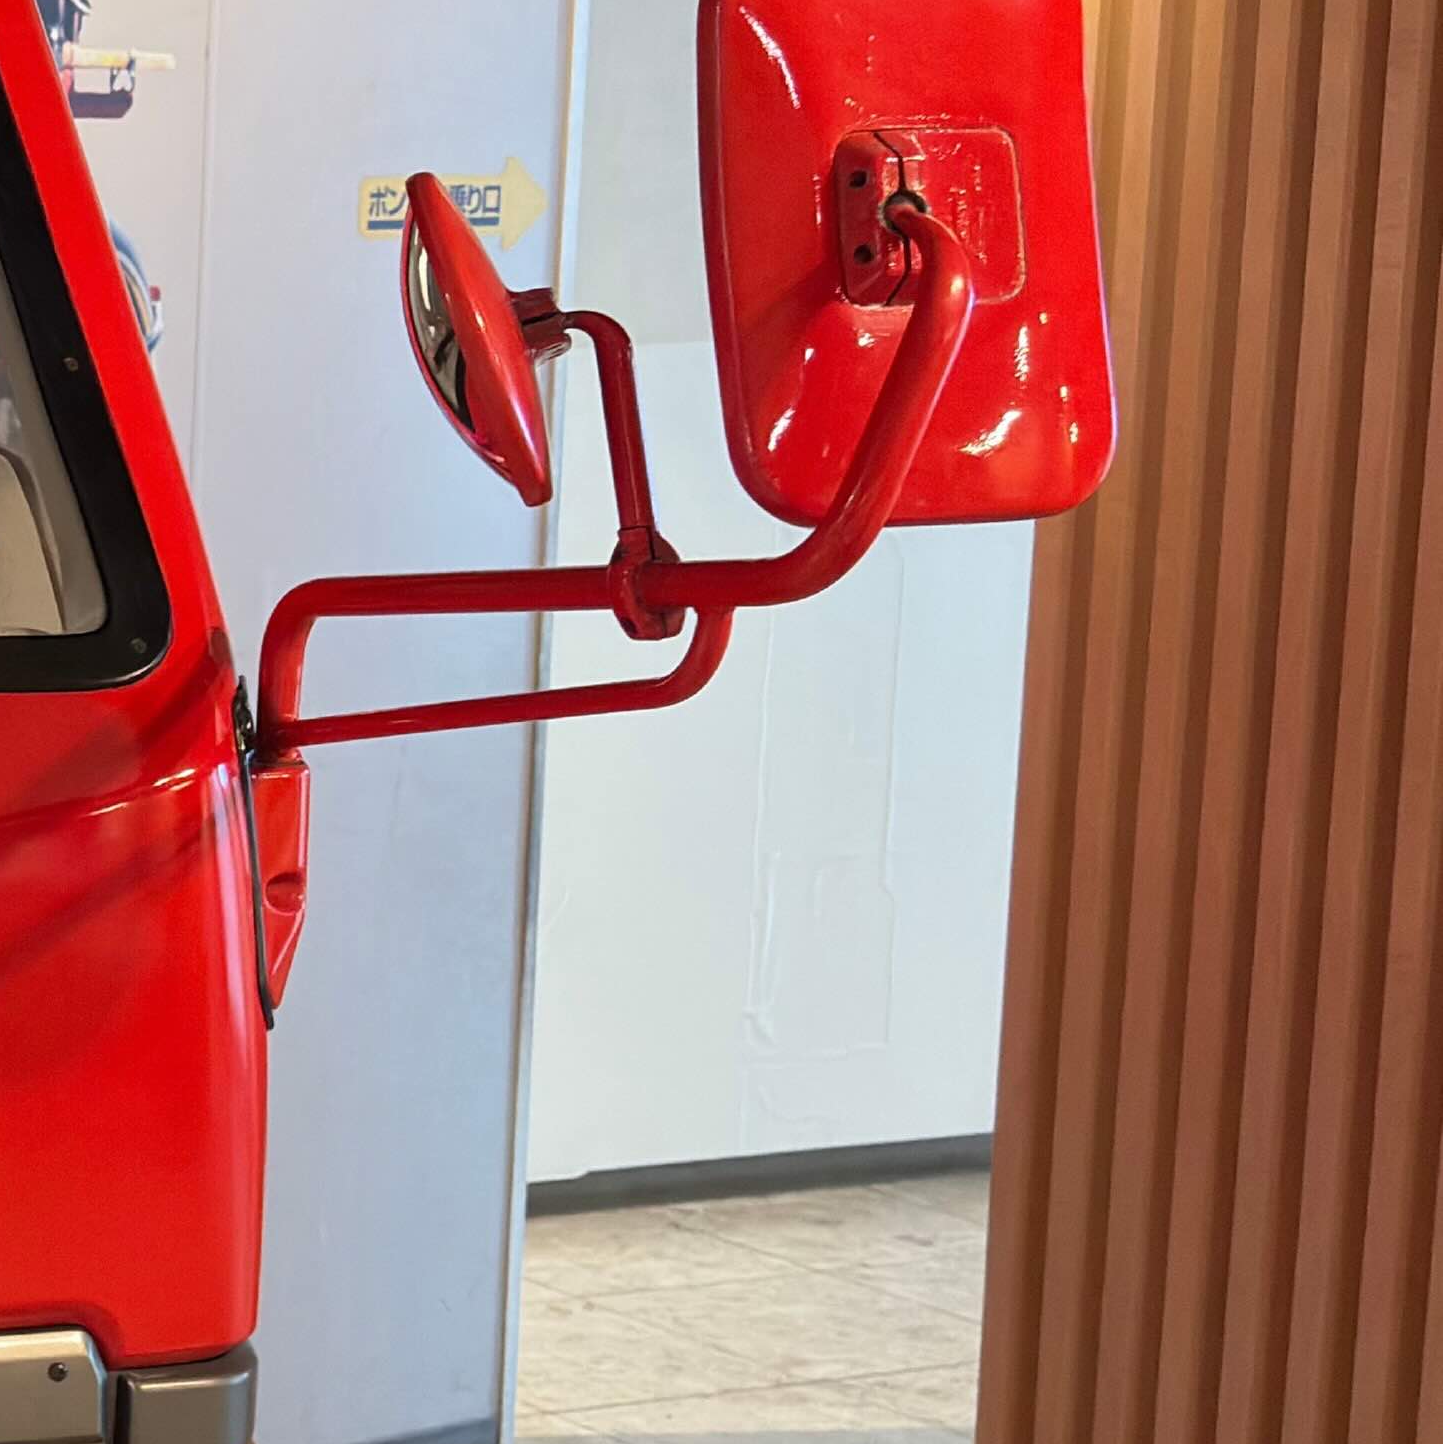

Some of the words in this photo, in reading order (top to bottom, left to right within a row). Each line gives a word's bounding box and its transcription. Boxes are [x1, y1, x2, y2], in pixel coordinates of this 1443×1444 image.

[369, 184, 502, 217] ポン乗り口
